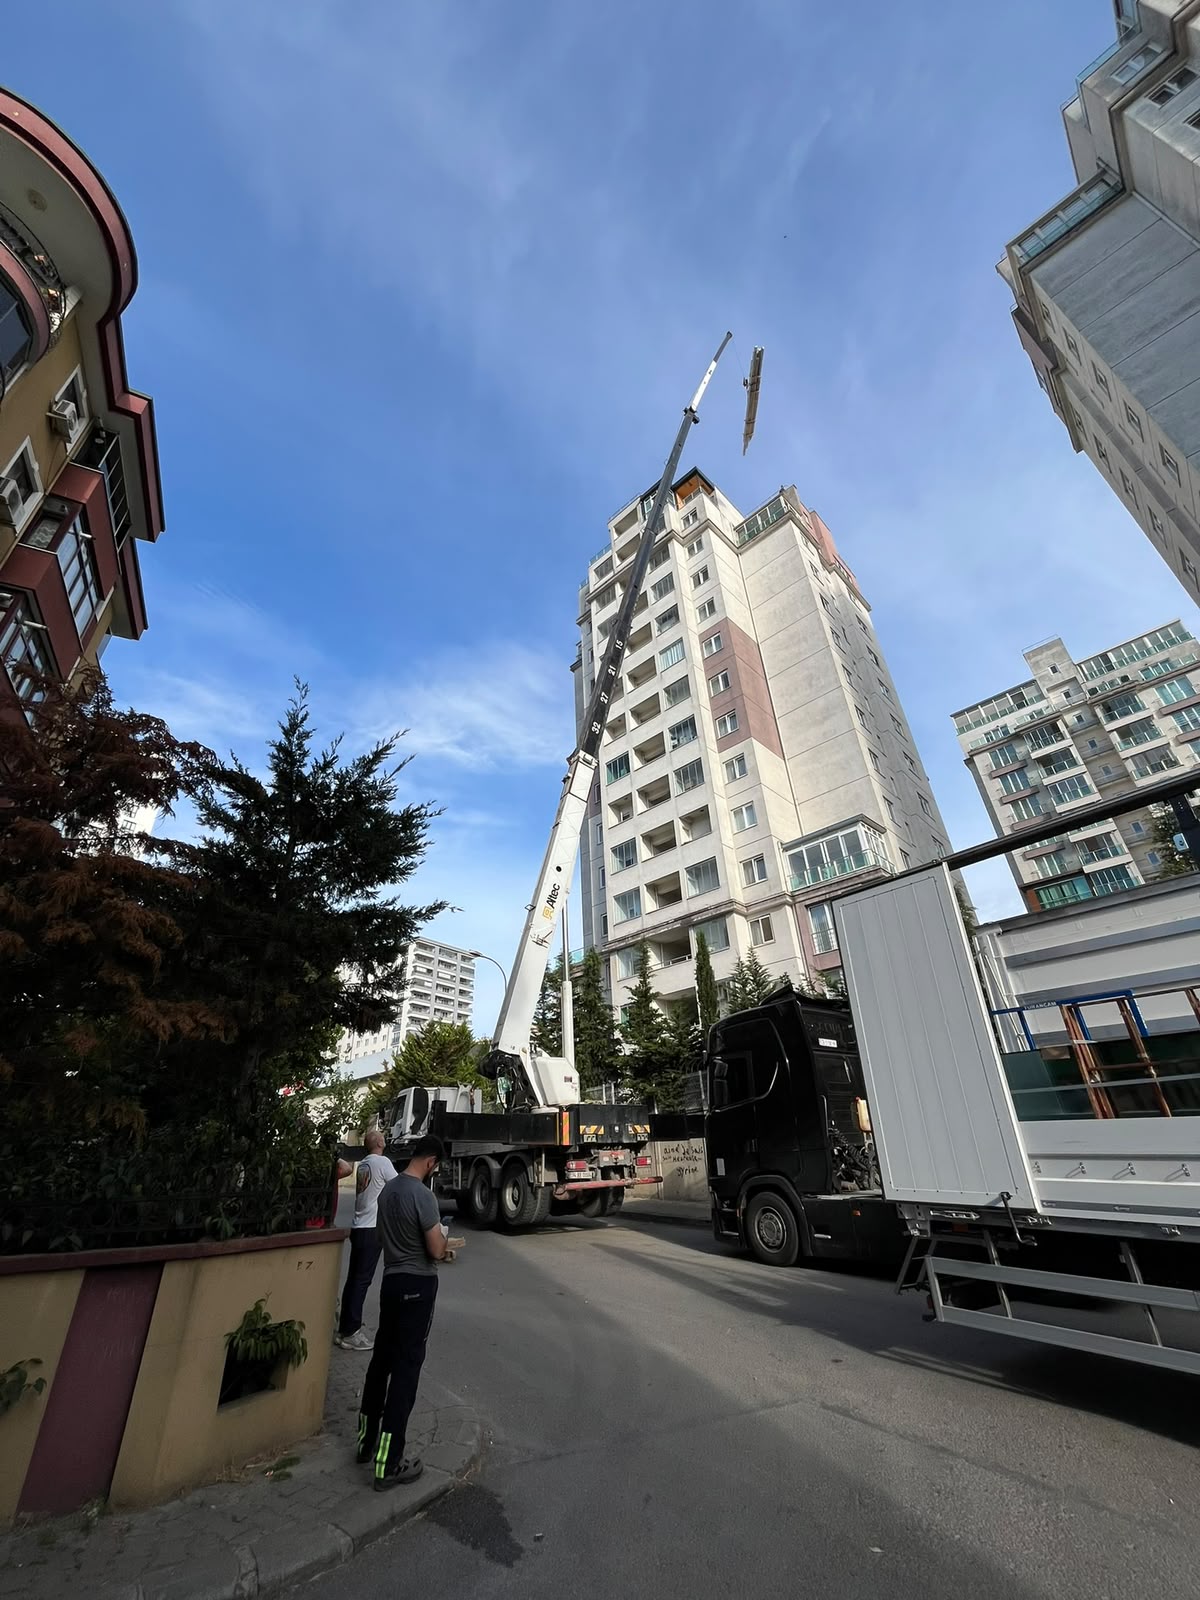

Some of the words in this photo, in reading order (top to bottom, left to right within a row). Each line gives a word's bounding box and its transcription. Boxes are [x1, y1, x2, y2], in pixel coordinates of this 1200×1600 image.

[615, 640, 624, 650] 15
[608, 665, 616, 677] 21
[601, 692, 609, 704] 27
[591, 722, 601, 735] 32
[546, 883, 561, 909] Altec
